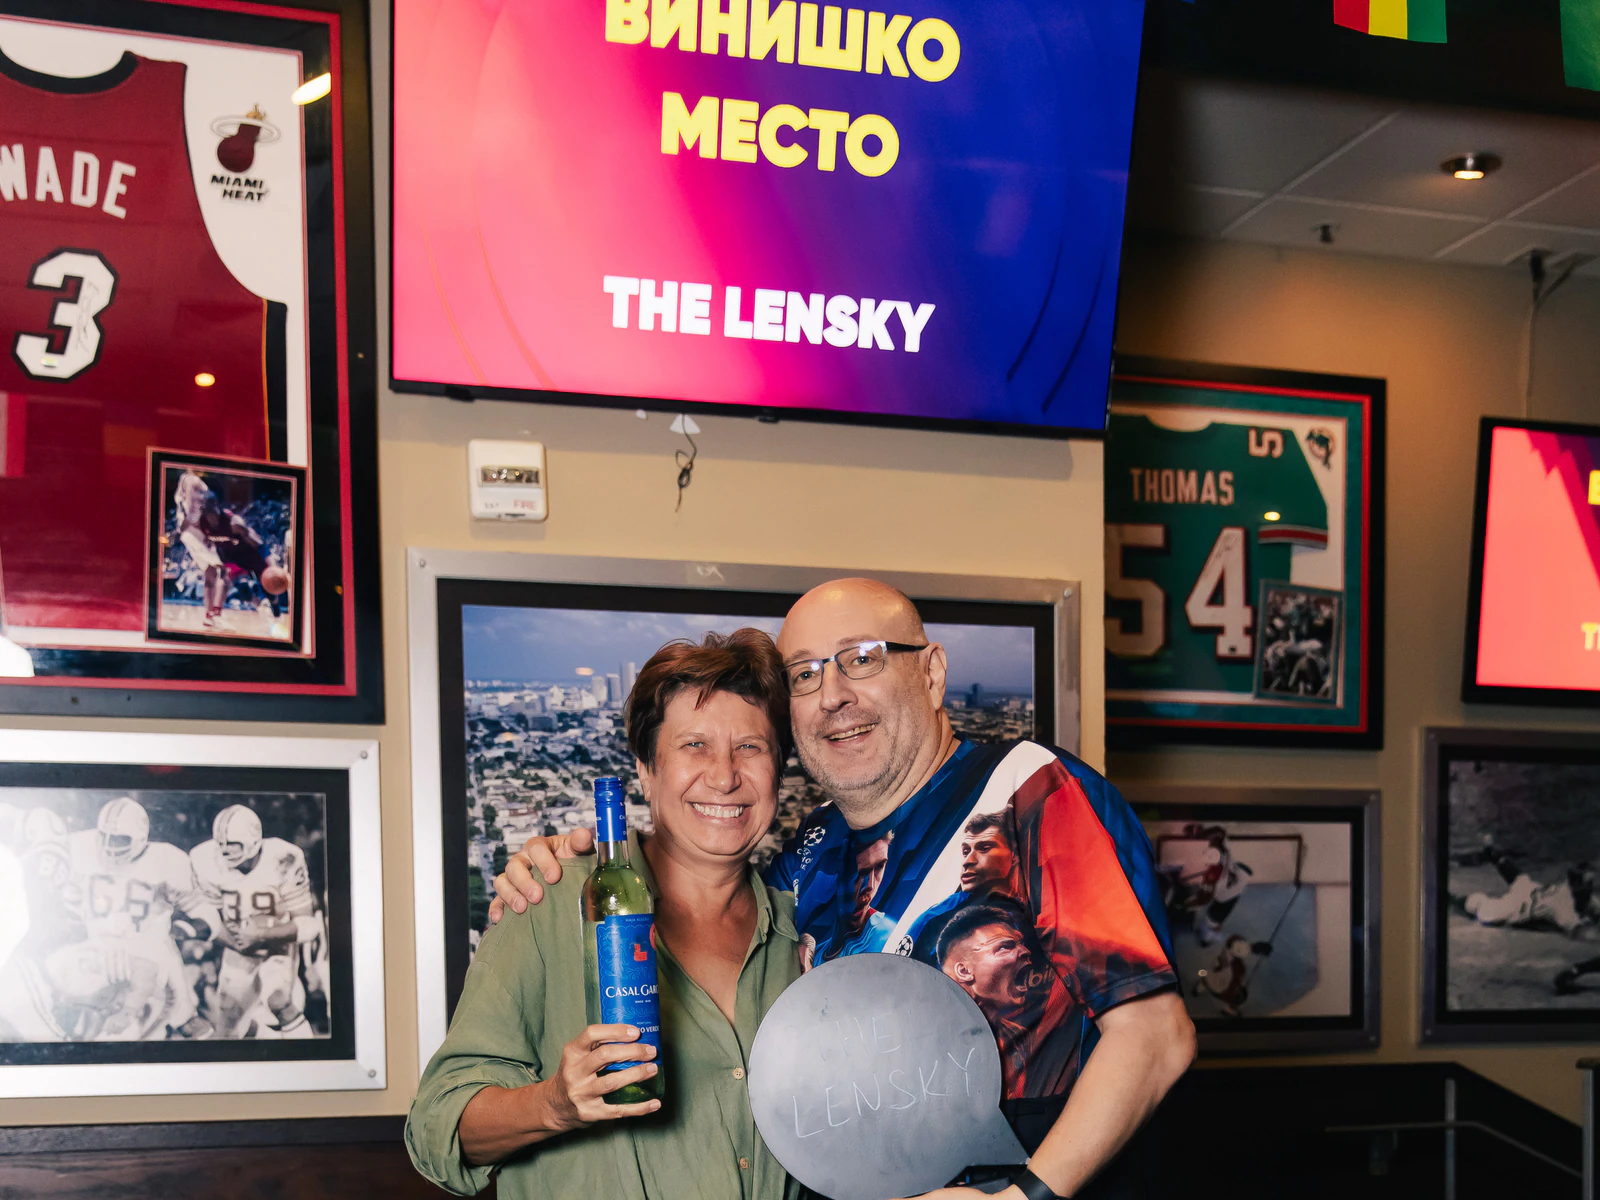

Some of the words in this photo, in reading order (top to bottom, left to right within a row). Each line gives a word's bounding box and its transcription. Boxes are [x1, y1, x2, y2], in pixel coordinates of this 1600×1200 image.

[605, 0, 960, 82] ВИНИШКО
[661, 91, 899, 177] МЕСТО
[211, 175, 264, 189] MIAMI
[222, 188, 265, 202] HEAT
[10, 246, 119, 383] 3
[603, 275, 712, 335] THE
[724, 286, 936, 353] LENSKY
[513, 499, 537, 510] FIRE
[1130, 467, 1235, 506] THOMAS
[605, 986, 640, 998] CASAL
[793, 1047, 976, 1138] LENSKY
